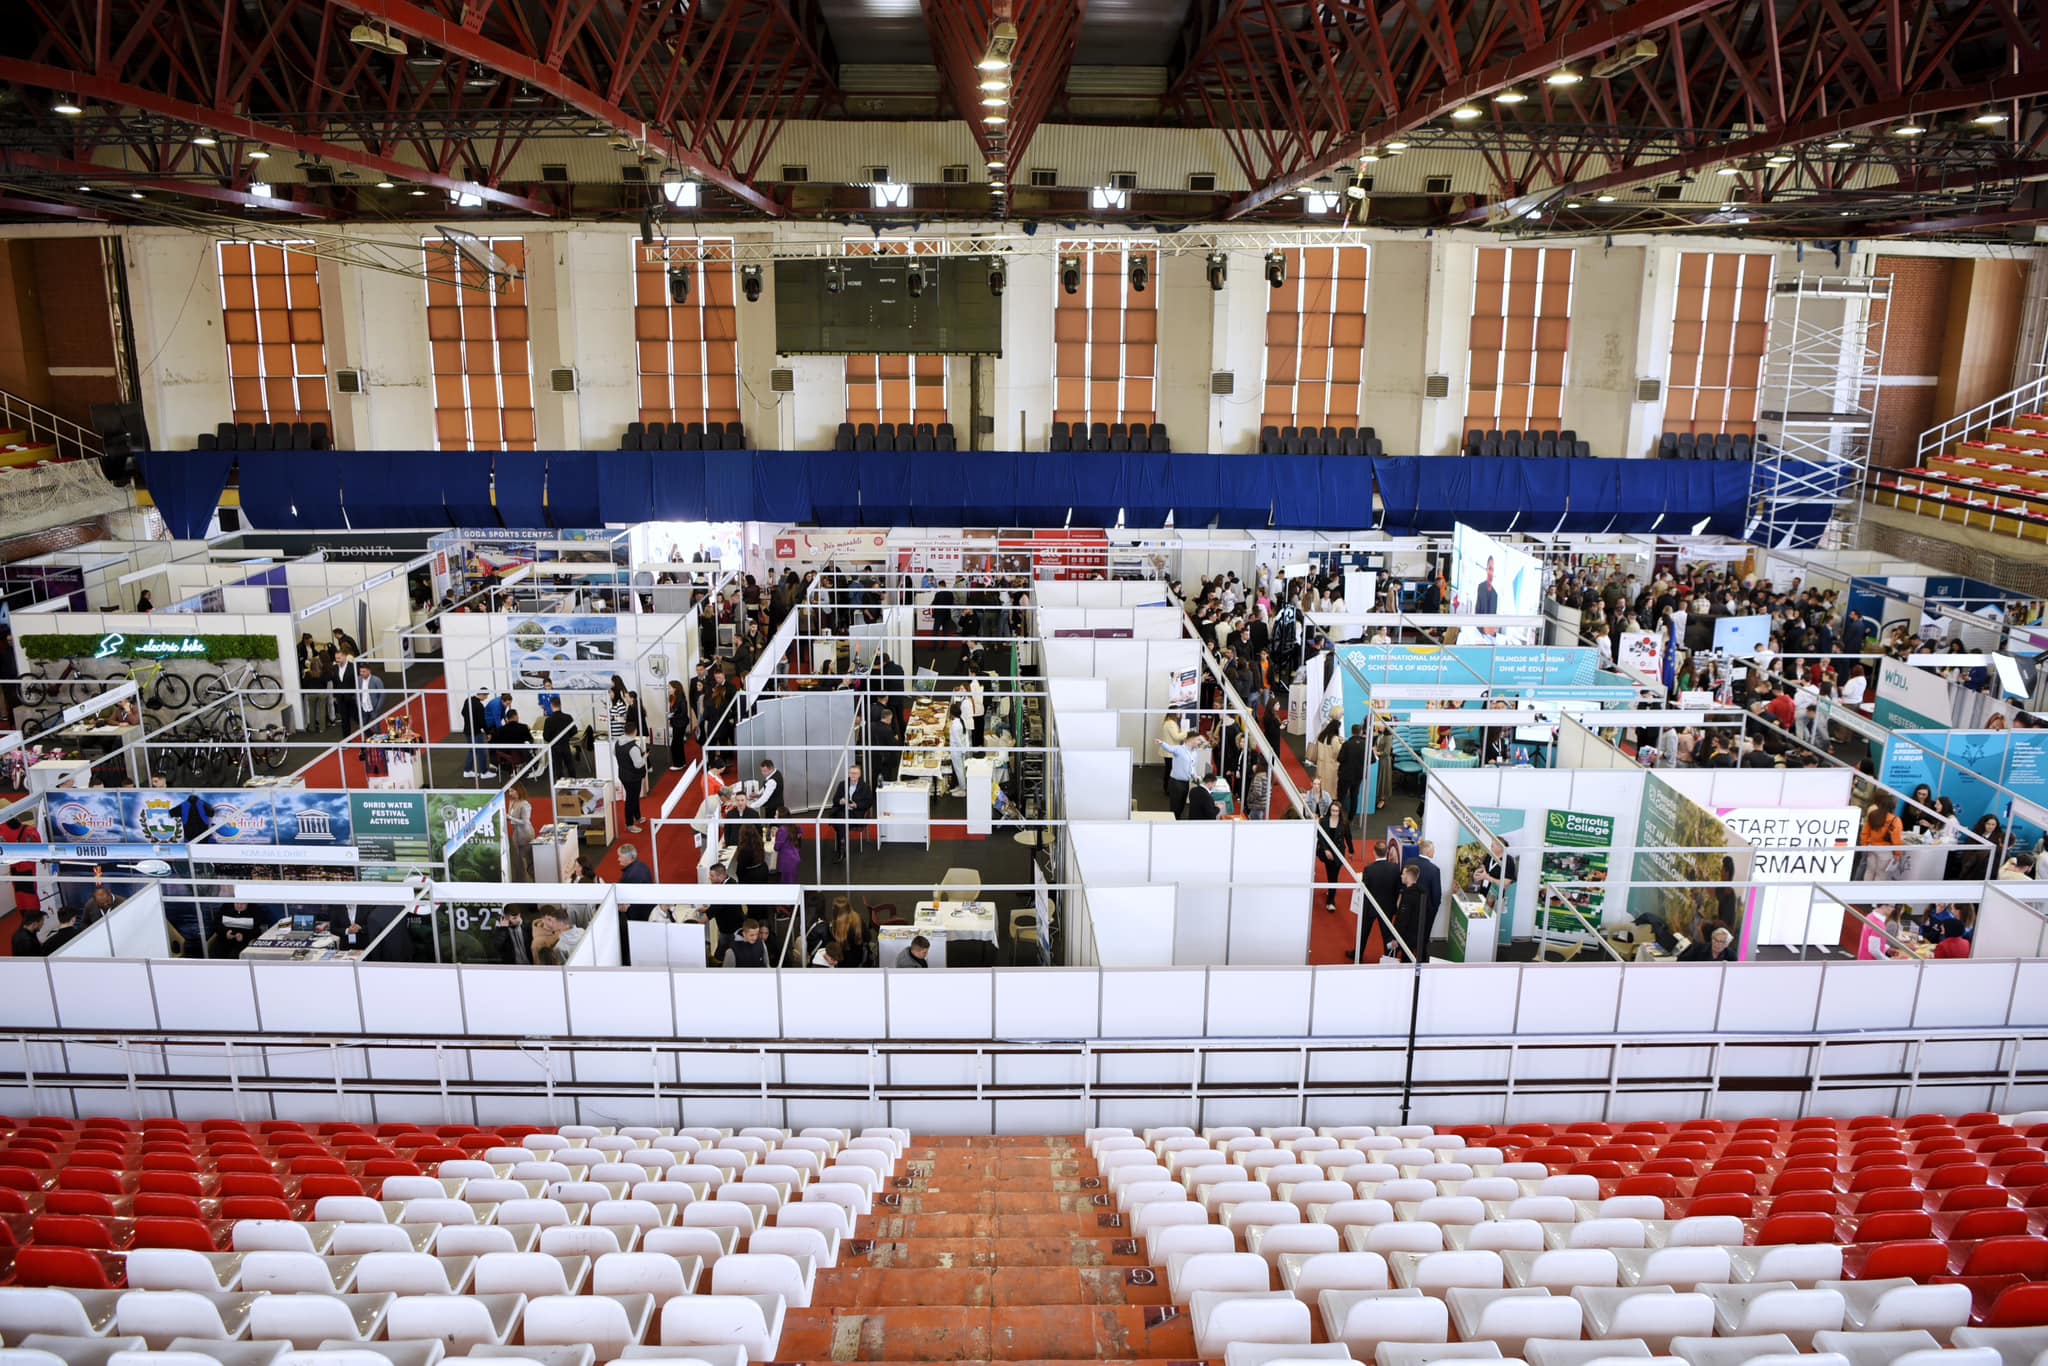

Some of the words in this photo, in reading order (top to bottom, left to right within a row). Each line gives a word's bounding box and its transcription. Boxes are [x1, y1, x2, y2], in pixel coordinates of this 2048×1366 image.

[341, 546, 394, 556] BONITA
[1567, 815, 1609, 827] Perrotis
[1726, 819, 1789, 834] START
[1796, 819, 1850, 834] YOUR
[1566, 822, 1610, 835] College
[76, 847, 108, 857] OHRID
[1756, 855, 1845, 874] RMANY
